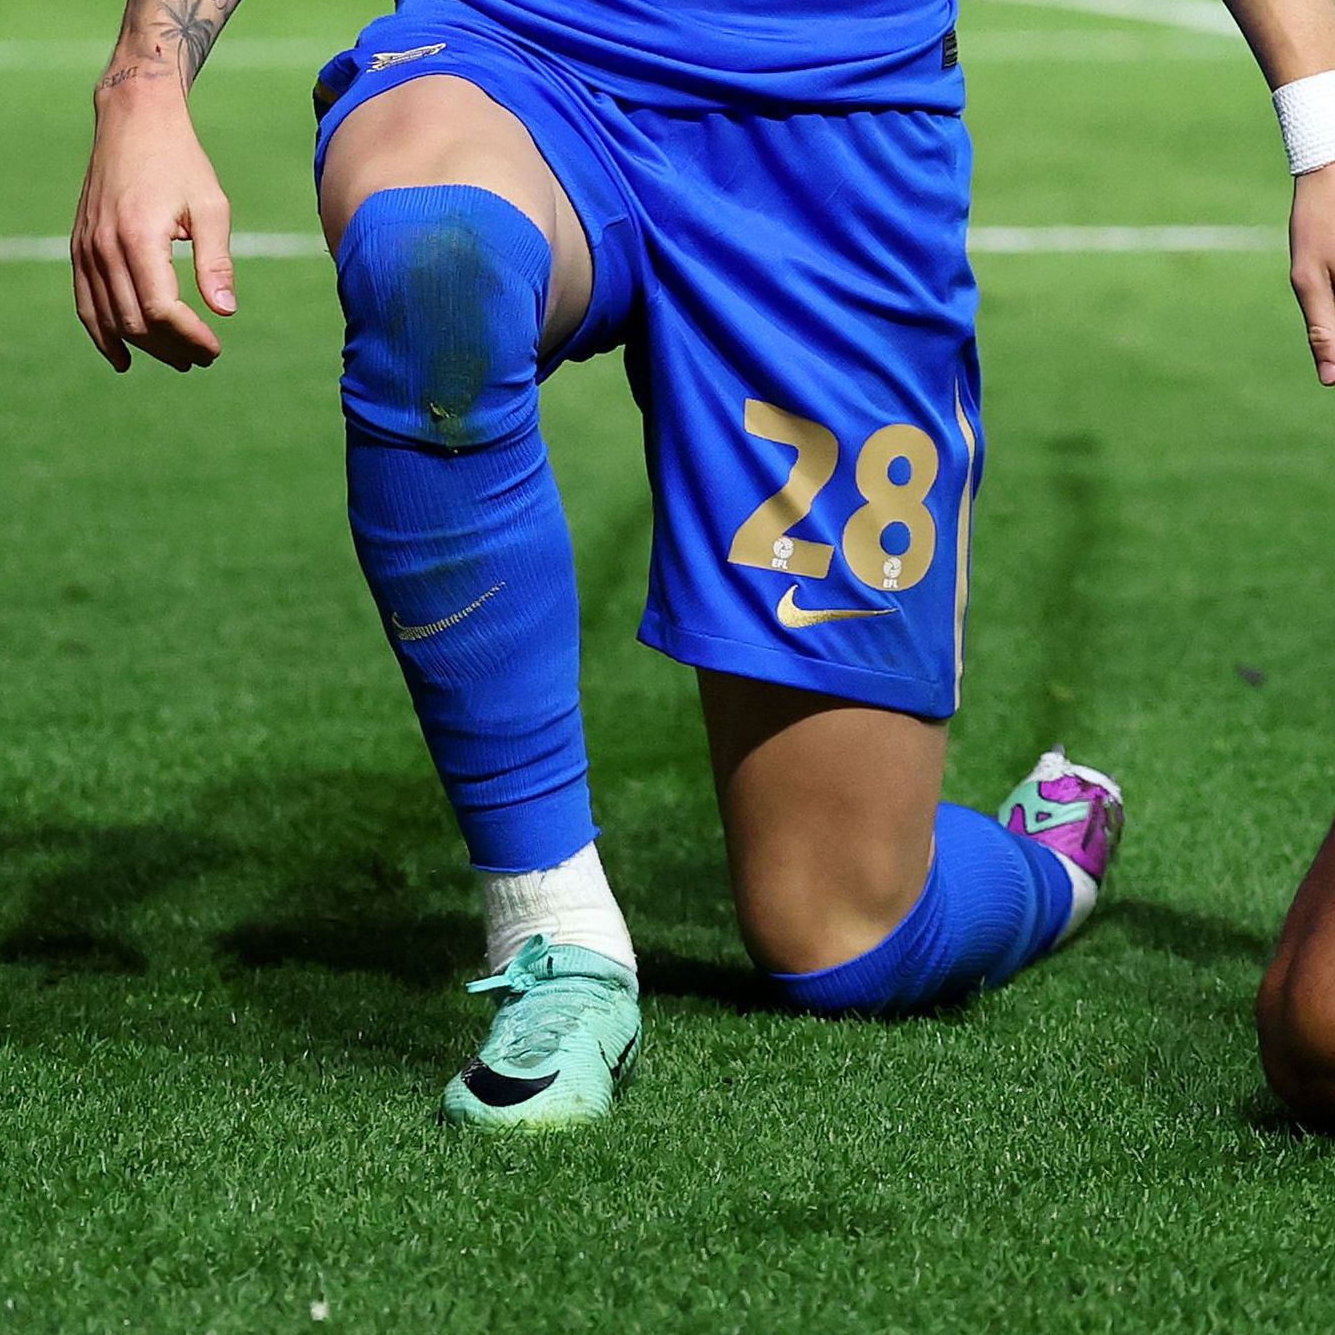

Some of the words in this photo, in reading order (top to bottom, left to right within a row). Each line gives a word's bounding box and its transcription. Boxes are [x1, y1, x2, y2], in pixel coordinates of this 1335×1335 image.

[727, 398, 939, 592] 28
[771, 557, 789, 570] EFL
[882, 577, 899, 590] EFL
